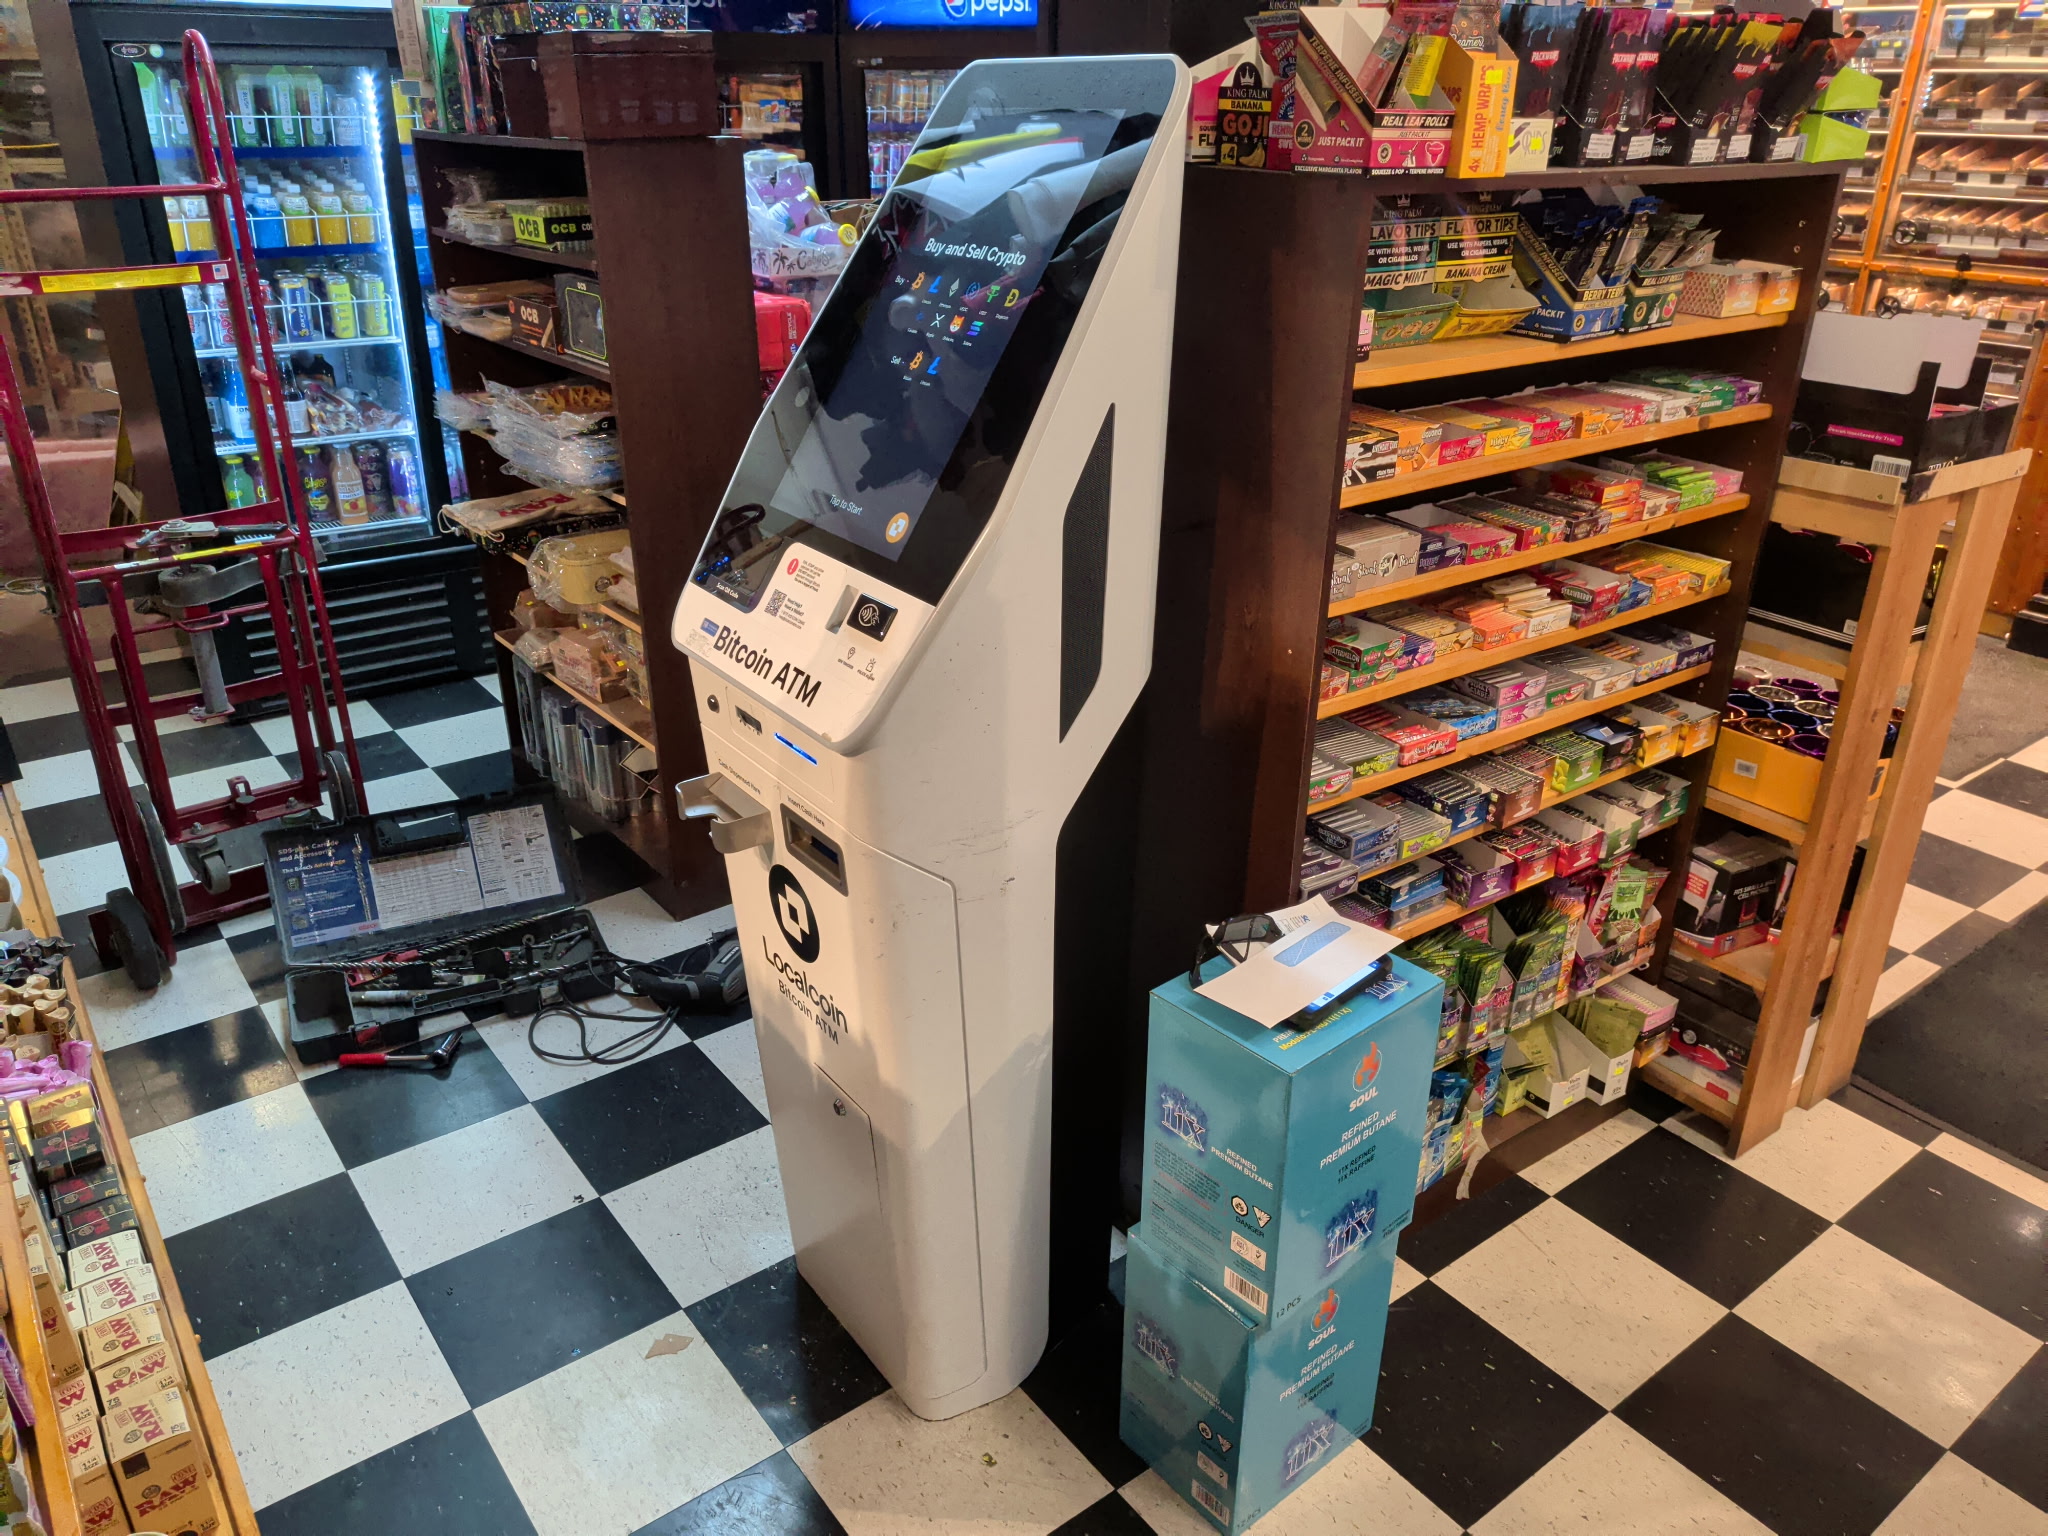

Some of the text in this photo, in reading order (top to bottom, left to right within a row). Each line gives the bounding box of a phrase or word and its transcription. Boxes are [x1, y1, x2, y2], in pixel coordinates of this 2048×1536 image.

[1309, 37, 1364, 105] TERPENE INFUSED
[1227, 88, 1268, 99] KING PALM
[1230, 101, 1264, 111] BANANA
[1223, 112, 1270, 137] GOJI
[1301, 124, 1308, 135] 2
[1381, 116, 1449, 127] REAL LEAF ROLLS
[1471, 113, 1487, 149] HEMP
[1317, 137, 1364, 147] JUST PACK IT
[518, 217, 540, 239] OCB
[551, 223, 577, 234] OCB
[1370, 223, 1436, 240] LAVOR TIPS
[1446, 217, 1514, 234] FLAVOR TIPS
[924, 237, 1026, 267] Buy and Sell Crypto
[1378, 254, 1418, 264] OR CIGARILLOS
[1470, 248, 1498, 256] CIGARILLOS
[894, 275, 906, 285] Buy
[1365, 270, 1428, 287] MAGIC MINT
[1444, 264, 1507, 279] BANANA CREAM
[577, 282, 587, 291] OCB
[1583, 289, 1605, 302] BERRY
[520, 305, 540, 324] OCB
[1536, 307, 1566, 319] PACK IT
[890, 355, 901, 365] Sell
[829, 494, 863, 516] Tap to Start
[716, 582, 739, 599] Scan QR Code
[1561, 587, 1593, 602] STRAWBERRY
[713, 626, 774, 680] Bitcoin
[771, 662, 822, 708] ATM
[787, 795, 825, 827] Insert Cash Here
[762, 934, 849, 1034] Localcoin
[778, 978, 839, 1045] Bitcoin ATM
[1349, 1087, 1379, 1112] SOUL
[1341, 1111, 1380, 1143] REFINED
[1320, 1109, 1398, 1170] PREMIUM BUTANE
[1211, 1146, 1274, 1190] PREMIUM BUTANE
[1226, 1148, 1257, 1172] REFINED
[1338, 1145, 1376, 1175] 11X REFINED
[1337, 1172, 1348, 1184] 11X
[1235, 1215, 1265, 1238] DANGER
[91, 1241, 120, 1272] RAW
[106, 1276, 137, 1309] RAW
[1276, 1296, 1302, 1319] 12 PCS
[108, 1317, 141, 1351] RAW
[1308, 1324, 1336, 1350] SOUL
[142, 1350, 166, 1364] CONE
[1301, 1343, 1338, 1376] REFINED
[104, 1354, 167, 1396] RAW
[1280, 1367, 1320, 1402] PREMIUM
[1321, 1340, 1355, 1374] BUTANE
[59, 1380, 85, 1397] CONE
[68, 1426, 92, 1442] CONE
[128, 1403, 165, 1443] RAW
[173, 1464, 196, 1482] CONE
[134, 1472, 198, 1518] RAW
